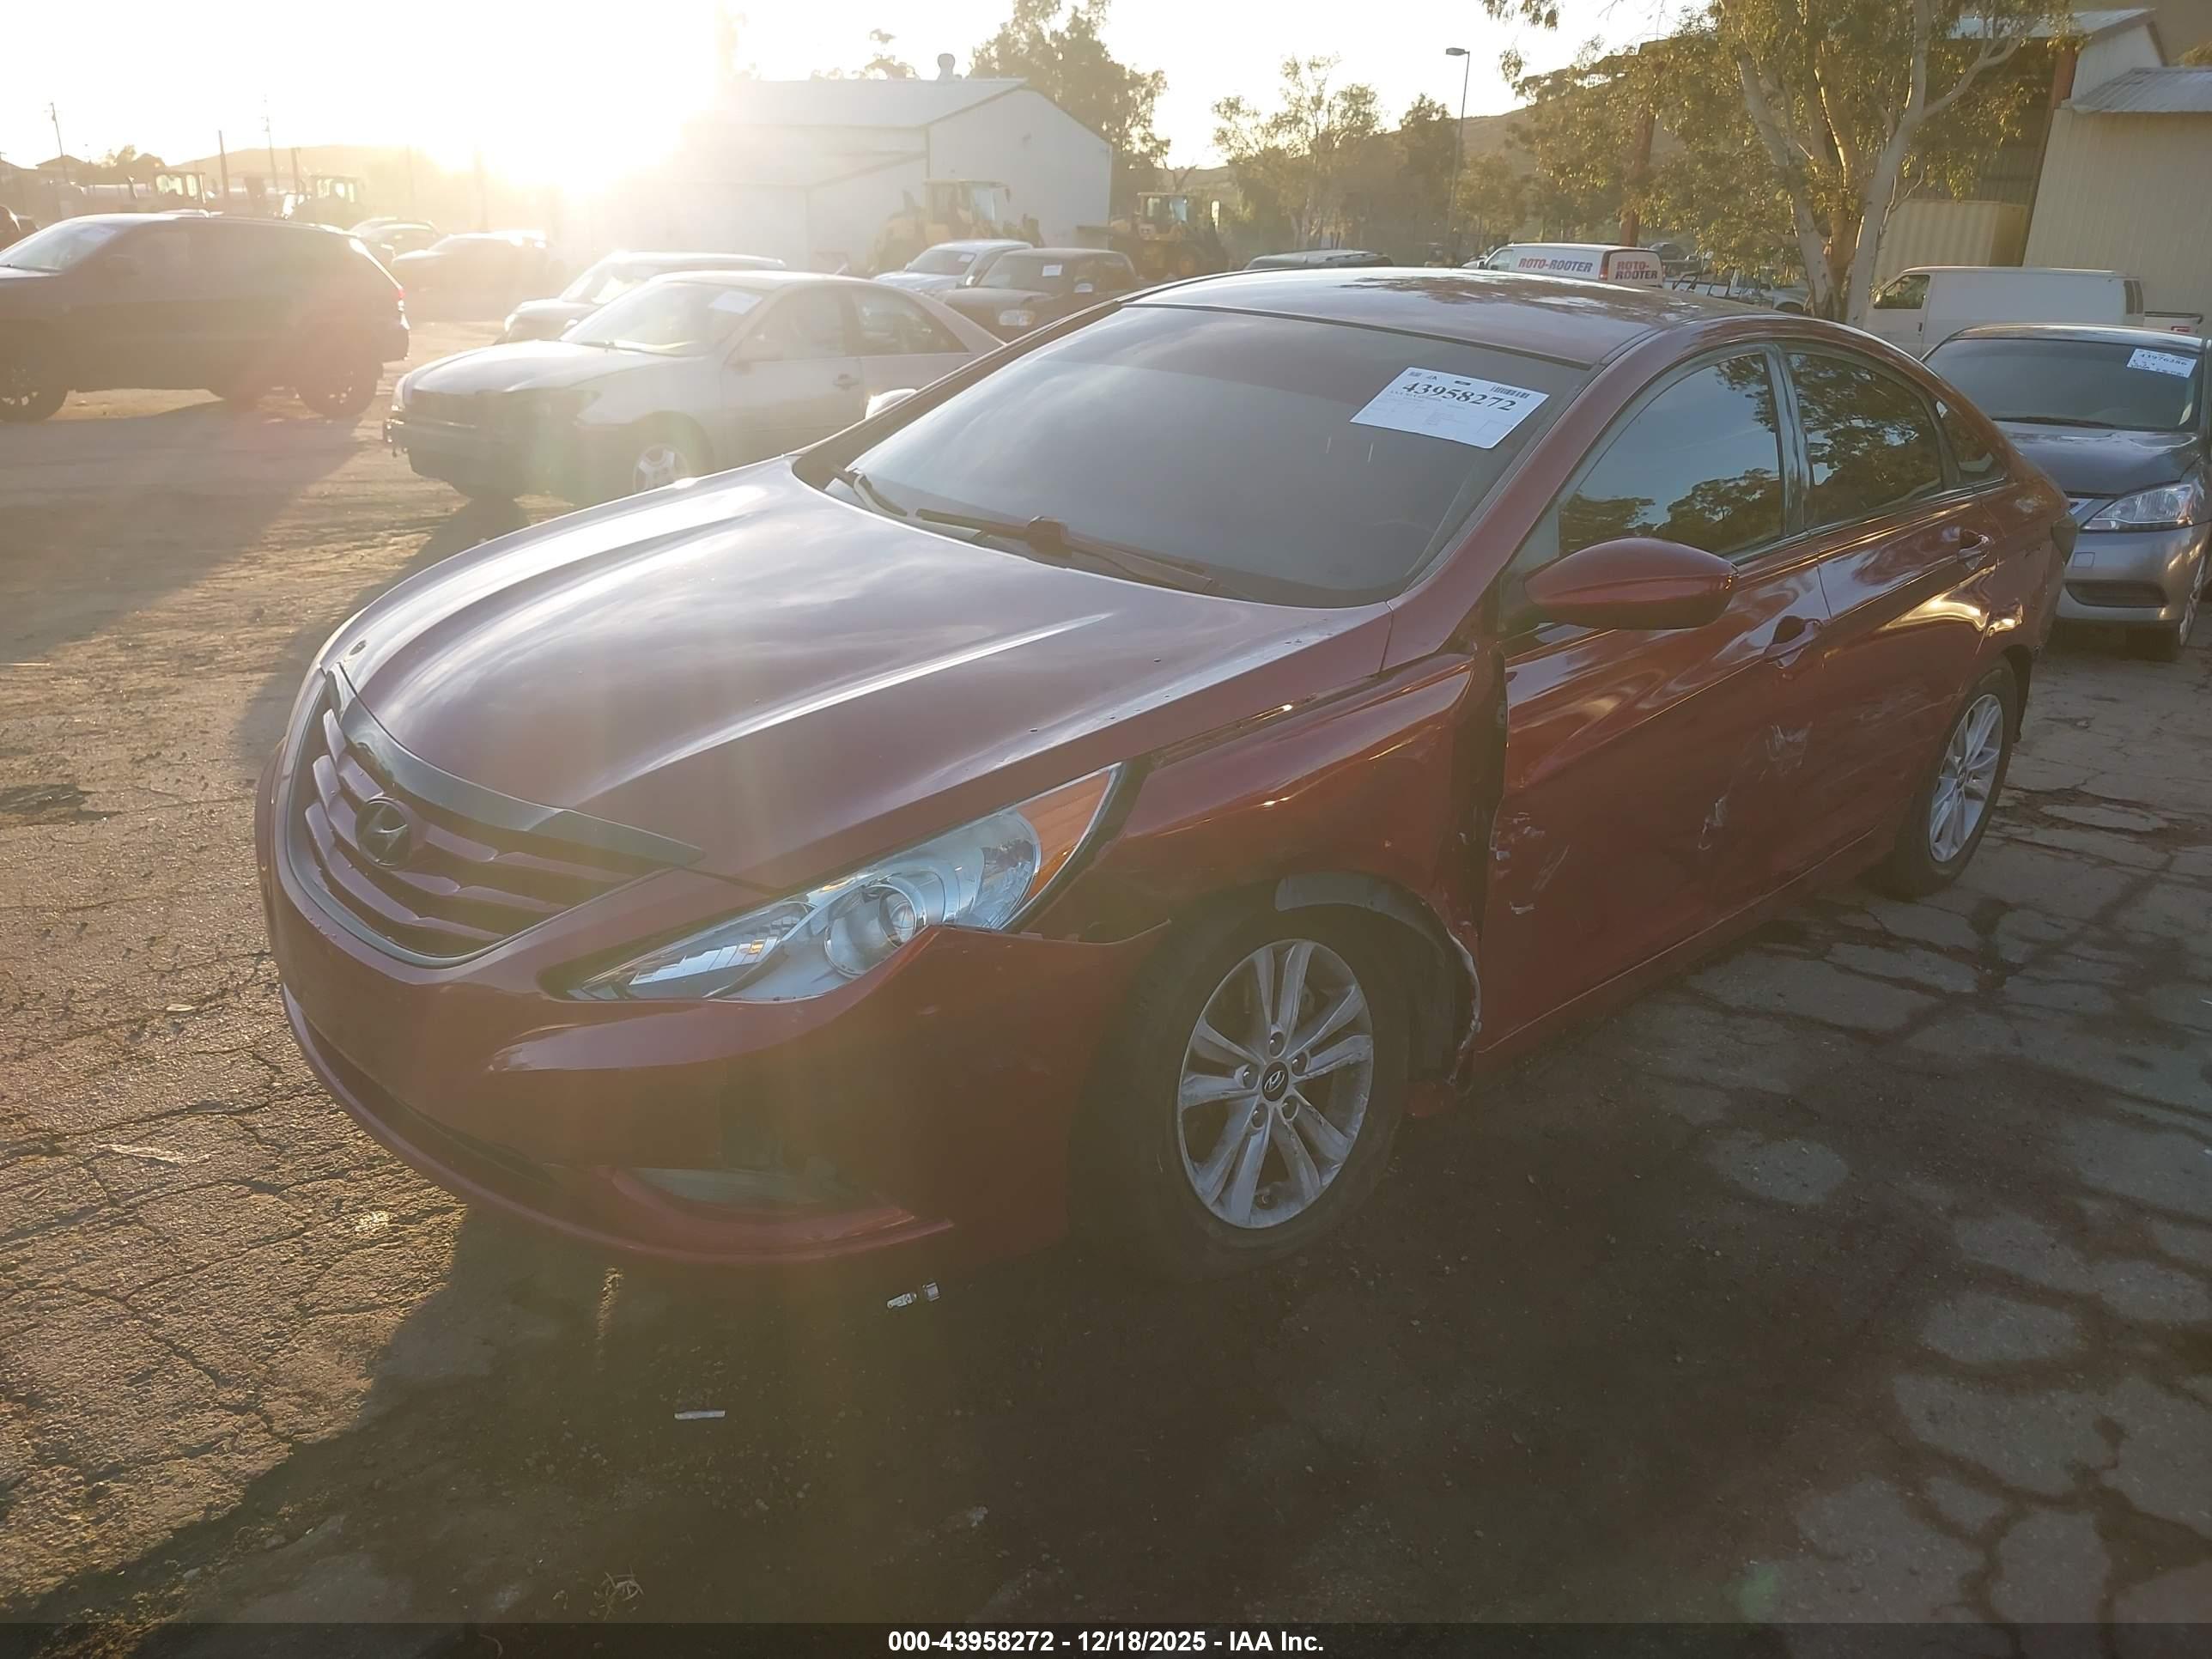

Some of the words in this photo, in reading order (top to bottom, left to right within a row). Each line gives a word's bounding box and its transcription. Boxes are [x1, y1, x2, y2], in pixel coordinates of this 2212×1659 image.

[1518, 258, 1593, 272] ROTO-ROOTER
[1617, 260, 1650, 270] ROTO-
[1614, 269, 1658, 280] ROOTER
[1402, 382, 1517, 411] 43958272
